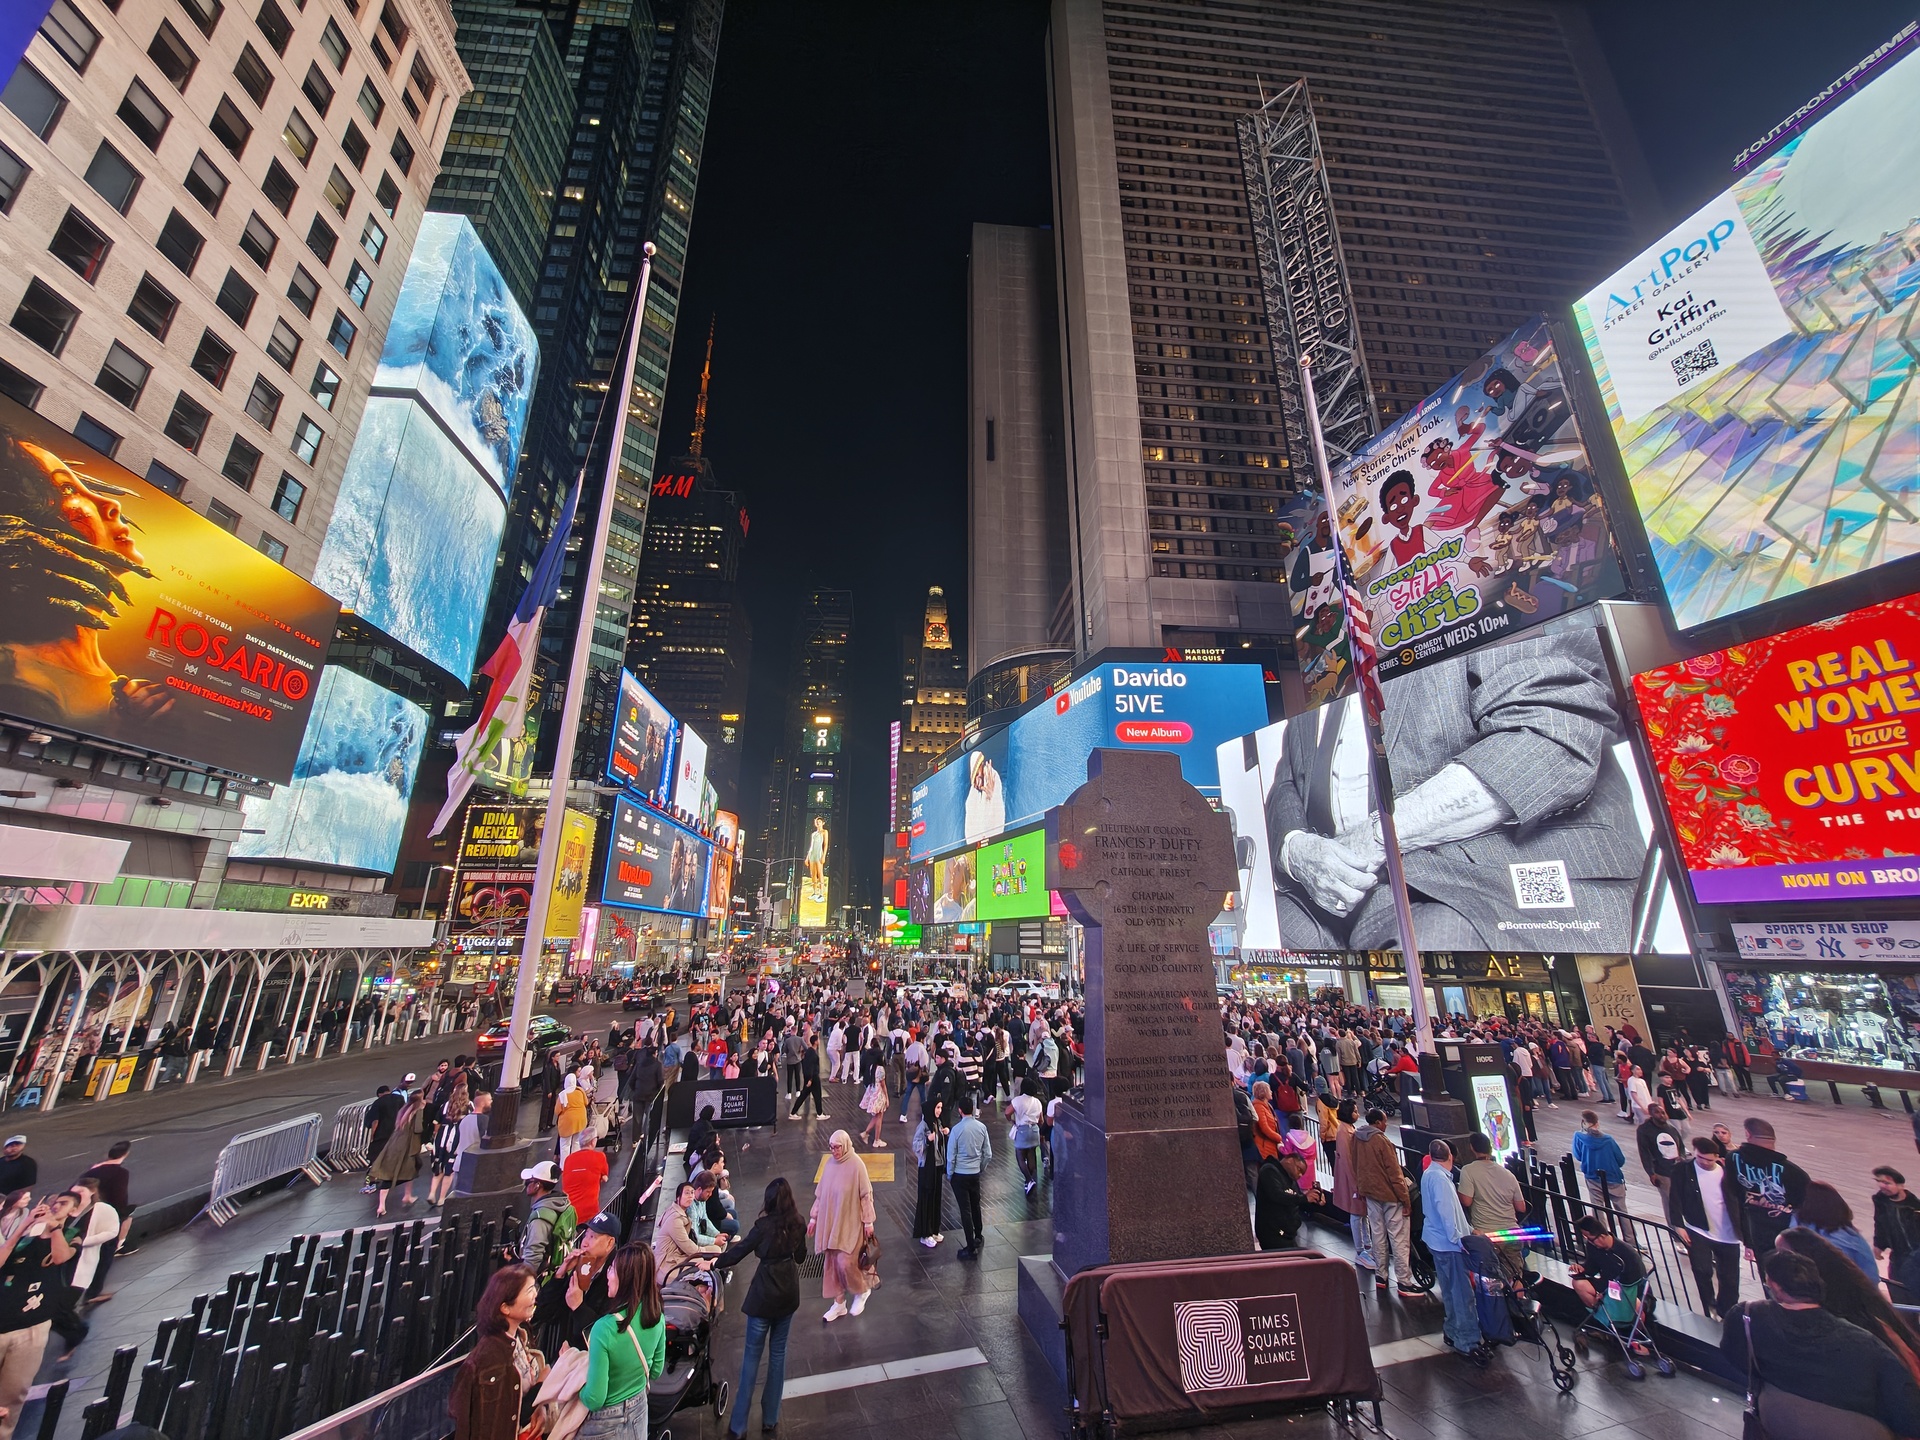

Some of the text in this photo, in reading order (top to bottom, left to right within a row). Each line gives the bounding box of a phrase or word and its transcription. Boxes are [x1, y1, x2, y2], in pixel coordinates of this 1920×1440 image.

[1301, 189, 1346, 328] OUTFITTERS
[1273, 176, 1325, 368] AMERICAN EAGLE
[1603, 219, 1735, 323] ArtPop
[1603, 253, 1711, 331] STREET GALLERY
[1657, 290, 1694, 321] Kai
[1648, 298, 1717, 345] Griffin
[1648, 309, 1727, 361] @hellokaigriffin
[1351, 455, 1363, 467] ROCK
[1421, 397, 1442, 416] ARNOLD
[1342, 414, 1444, 490] New Stories. New Look.
[1366, 446, 1420, 486] Same Chris.
[652, 474, 695, 498] H&M
[1368, 536, 1463, 596] everybody
[170, 565, 192, 581] YOU
[199, 580, 232, 601] CAN'T
[274, 619, 291, 633] THE
[295, 630, 321, 649] CURSE
[1406, 581, 1451, 617] hates
[159, 592, 233, 632] EMERAUDE TOUBIA
[1380, 587, 1478, 647] chris
[1443, 613, 1510, 649] WEDS 10PM
[245, 633, 315, 671] DAVID DASTMALCHIAN
[1413, 636, 1442, 653] COMEDY
[1415, 643, 1445, 660] CENTRAL
[145, 606, 310, 701] ROSARIO
[1379, 658, 1399, 672] SERIES
[1785, 638, 1911, 694] REAL
[1113, 668, 1187, 687] Davido
[165, 675, 190, 692] ONLY
[190, 684, 204, 697] IN
[202, 688, 242, 711] THEATERS
[241, 700, 266, 720] MAY
[263, 708, 274, 722] 2
[1069, 675, 1102, 707] YouTube
[1115, 694, 1164, 713] 5IVE
[1774, 672, 1920, 733] WOME
[1126, 727, 1182, 737] New Album
[1845, 724, 1908, 748] have
[482, 812, 515, 826] IDINA
[1819, 812, 1866, 829] THE
[471, 825, 520, 840] MENZEL
[1101, 823, 1194, 836] LIEUTENANT COLONEL
[465, 844, 520, 858] REDWOOD
[1094, 835, 1202, 850] FRANCIS DUFFY
[1102, 852, 1198, 862] MAY 2 26 1932
[1110, 867, 1191, 878] CATHOLIC PRIEST
[1781, 867, 1920, 889] NOW ON BRO
[1131, 891, 1175, 900] CHAPLAIN
[1113, 905, 1137, 914] 165TH
[1125, 918, 1166, 927] OLD 69TH
[1497, 920, 1601, 931] @BorrowedSpotlight
[1765, 923, 1889, 935] SPORTS FAN SHOP
[1117, 943, 1199, 953] A LIFE OF SERVICE
[1114, 964, 1205, 973] GOD AND COUNTRY
[1486, 954, 1523, 977] AE
[1114, 990, 1210, 999] SPANISH AMERICAN WAR
[1597, 981, 1627, 993] live
[1104, 1002, 1219, 1012] NEW YORK NATIONAL GUARD
[1590, 993, 1636, 1005] your
[1600, 1003, 1635, 1018] life
[1127, 1015, 1200, 1024] MEXICAN BORDER
[1137, 1028, 1193, 1038] WORLD WAR
[1168, 1054, 1199, 1064] SERVICE
[1201, 1054, 1227, 1064] CROSS
[1169, 1068, 1201, 1077] SERVICE
[1202, 1067, 1229, 1076] MEDAL
[1170, 1081, 1201, 1090] SERVICE
[1204, 1080, 1230, 1089] CROSS
[723, 1100, 745, 1108] SQUARE
[1163, 1109, 1175, 1118] DE
[1249, 1313, 1290, 1331] TIMES
[1247, 1331, 1297, 1351] SQUARE
[1253, 1350, 1297, 1365] ALLIANCE
